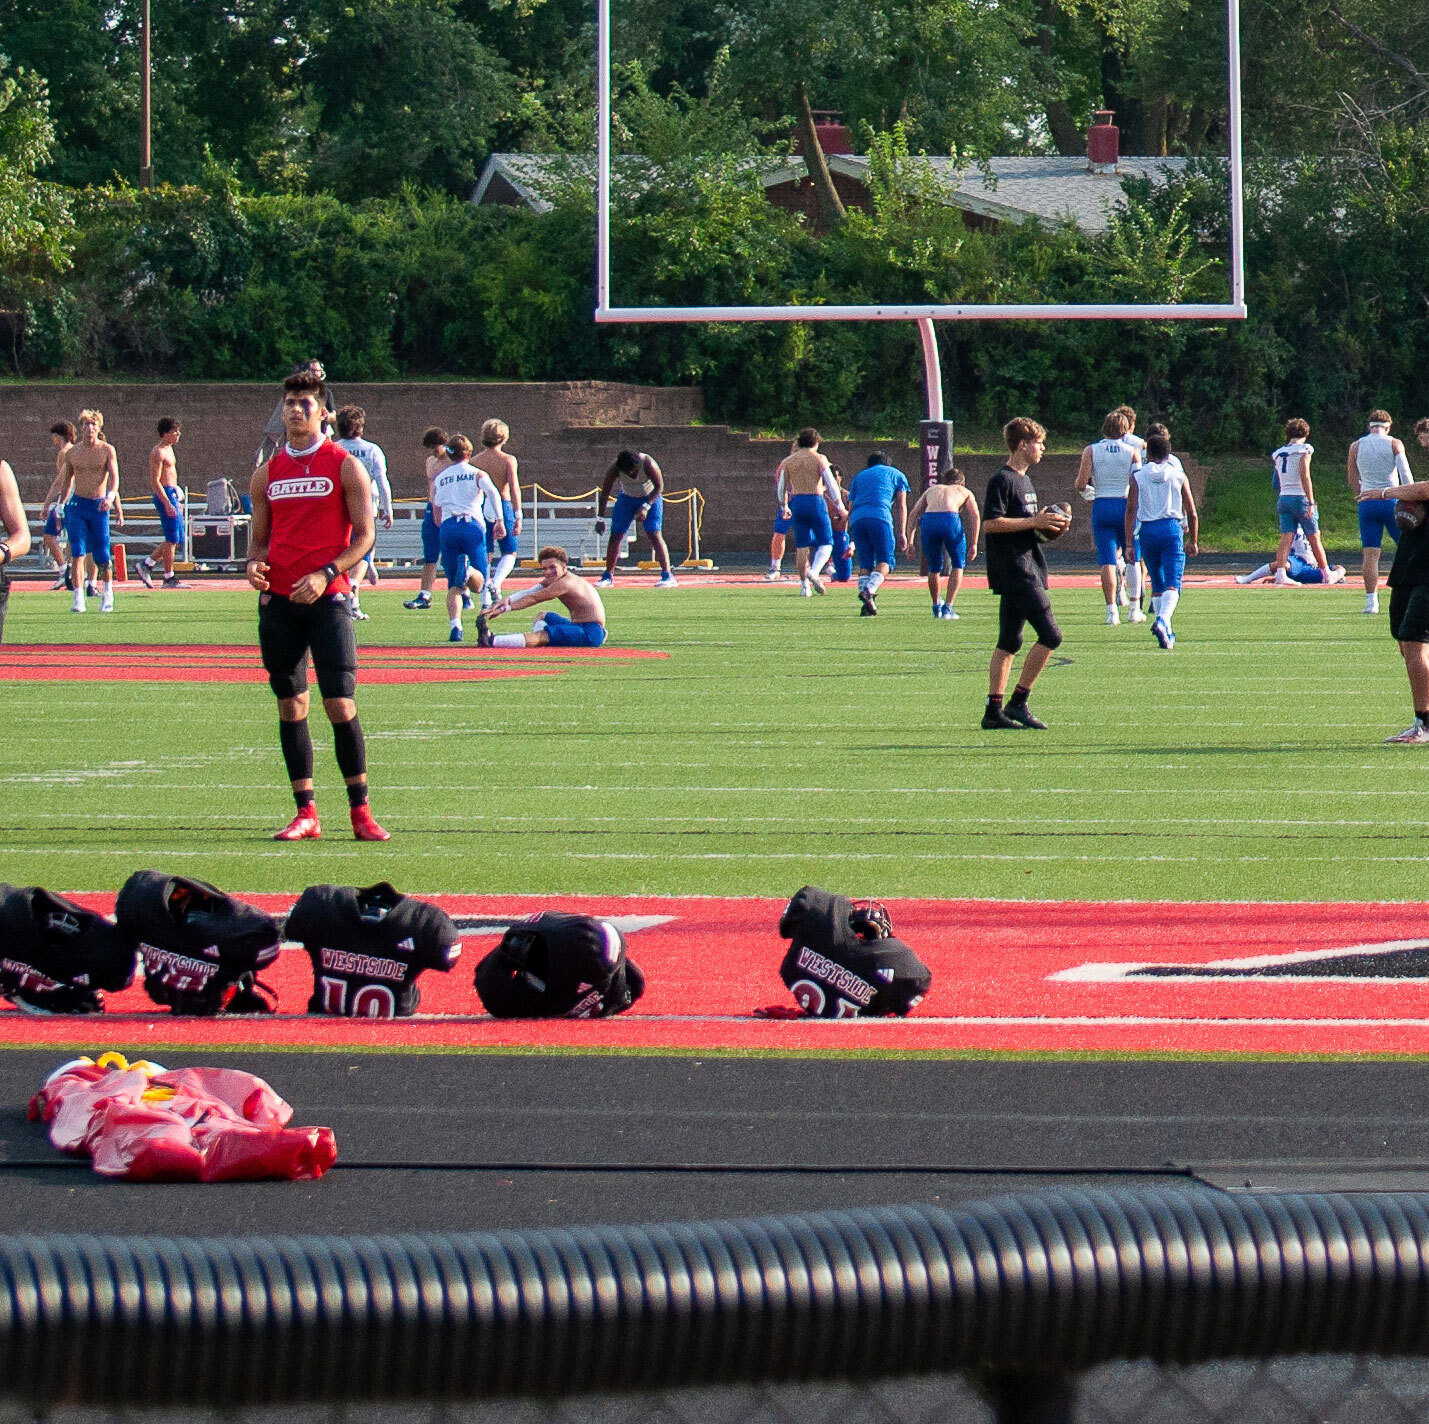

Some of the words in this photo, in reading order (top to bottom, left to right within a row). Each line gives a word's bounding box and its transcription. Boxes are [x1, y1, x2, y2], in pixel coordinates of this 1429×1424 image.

[271, 479, 327, 496] BATTLE
[320, 947, 408, 981] WESTSIDE
[798, 946, 878, 1007] WESTSIDE
